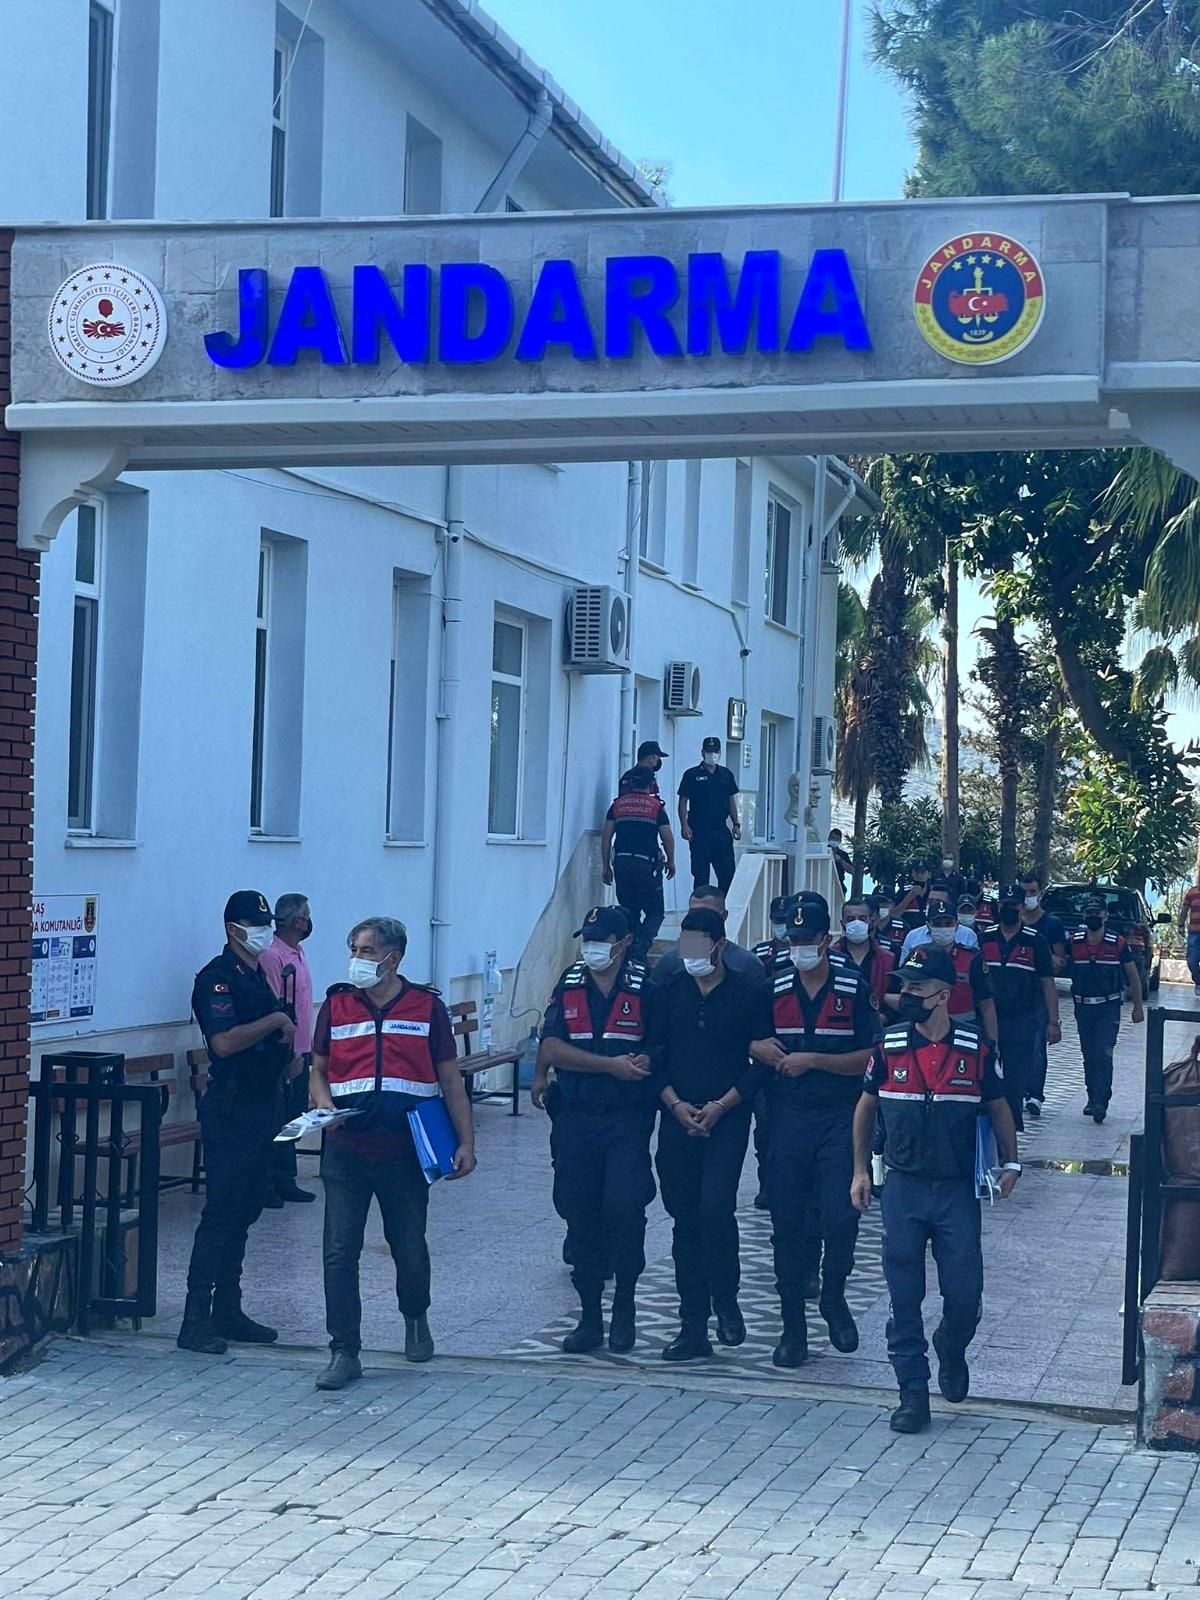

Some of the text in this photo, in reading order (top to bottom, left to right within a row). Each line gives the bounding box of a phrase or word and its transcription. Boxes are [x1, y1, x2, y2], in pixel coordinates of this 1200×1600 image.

[922, 236, 1037, 289] JANDARMA
[204, 249, 873, 370] JANDARMA
[40, 916, 83, 933] KOMUTANLIĞI
